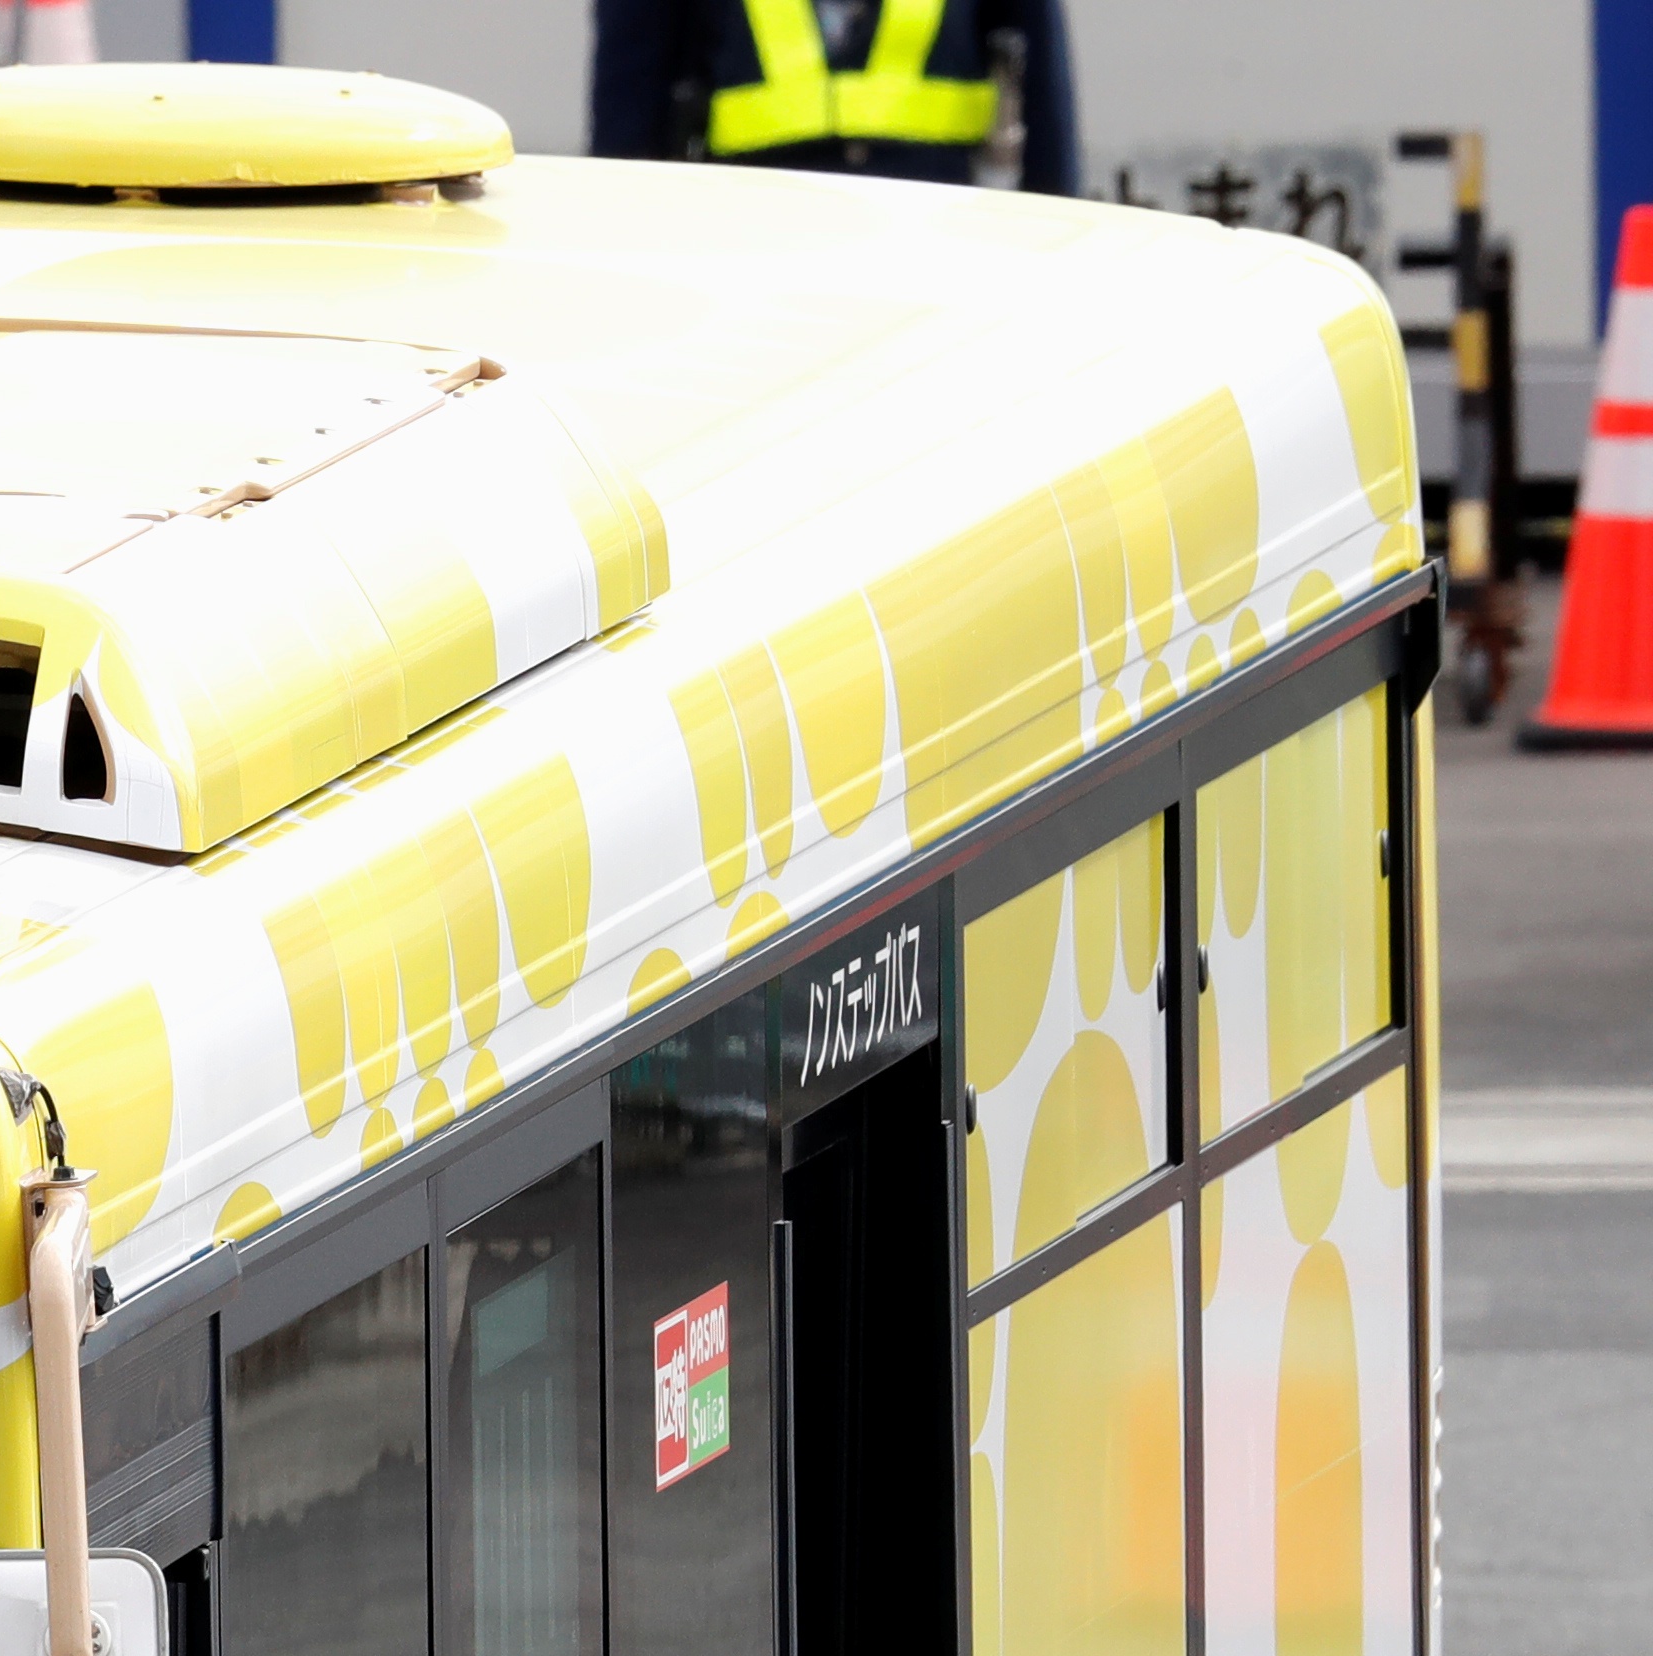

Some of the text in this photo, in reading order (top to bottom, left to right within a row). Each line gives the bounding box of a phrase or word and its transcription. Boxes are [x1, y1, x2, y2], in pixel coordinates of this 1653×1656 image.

[800, 922, 922, 1088] ノンステップバス
[690, 1304, 726, 1369] PASMO
[692, 1391, 725, 1450] Suica
